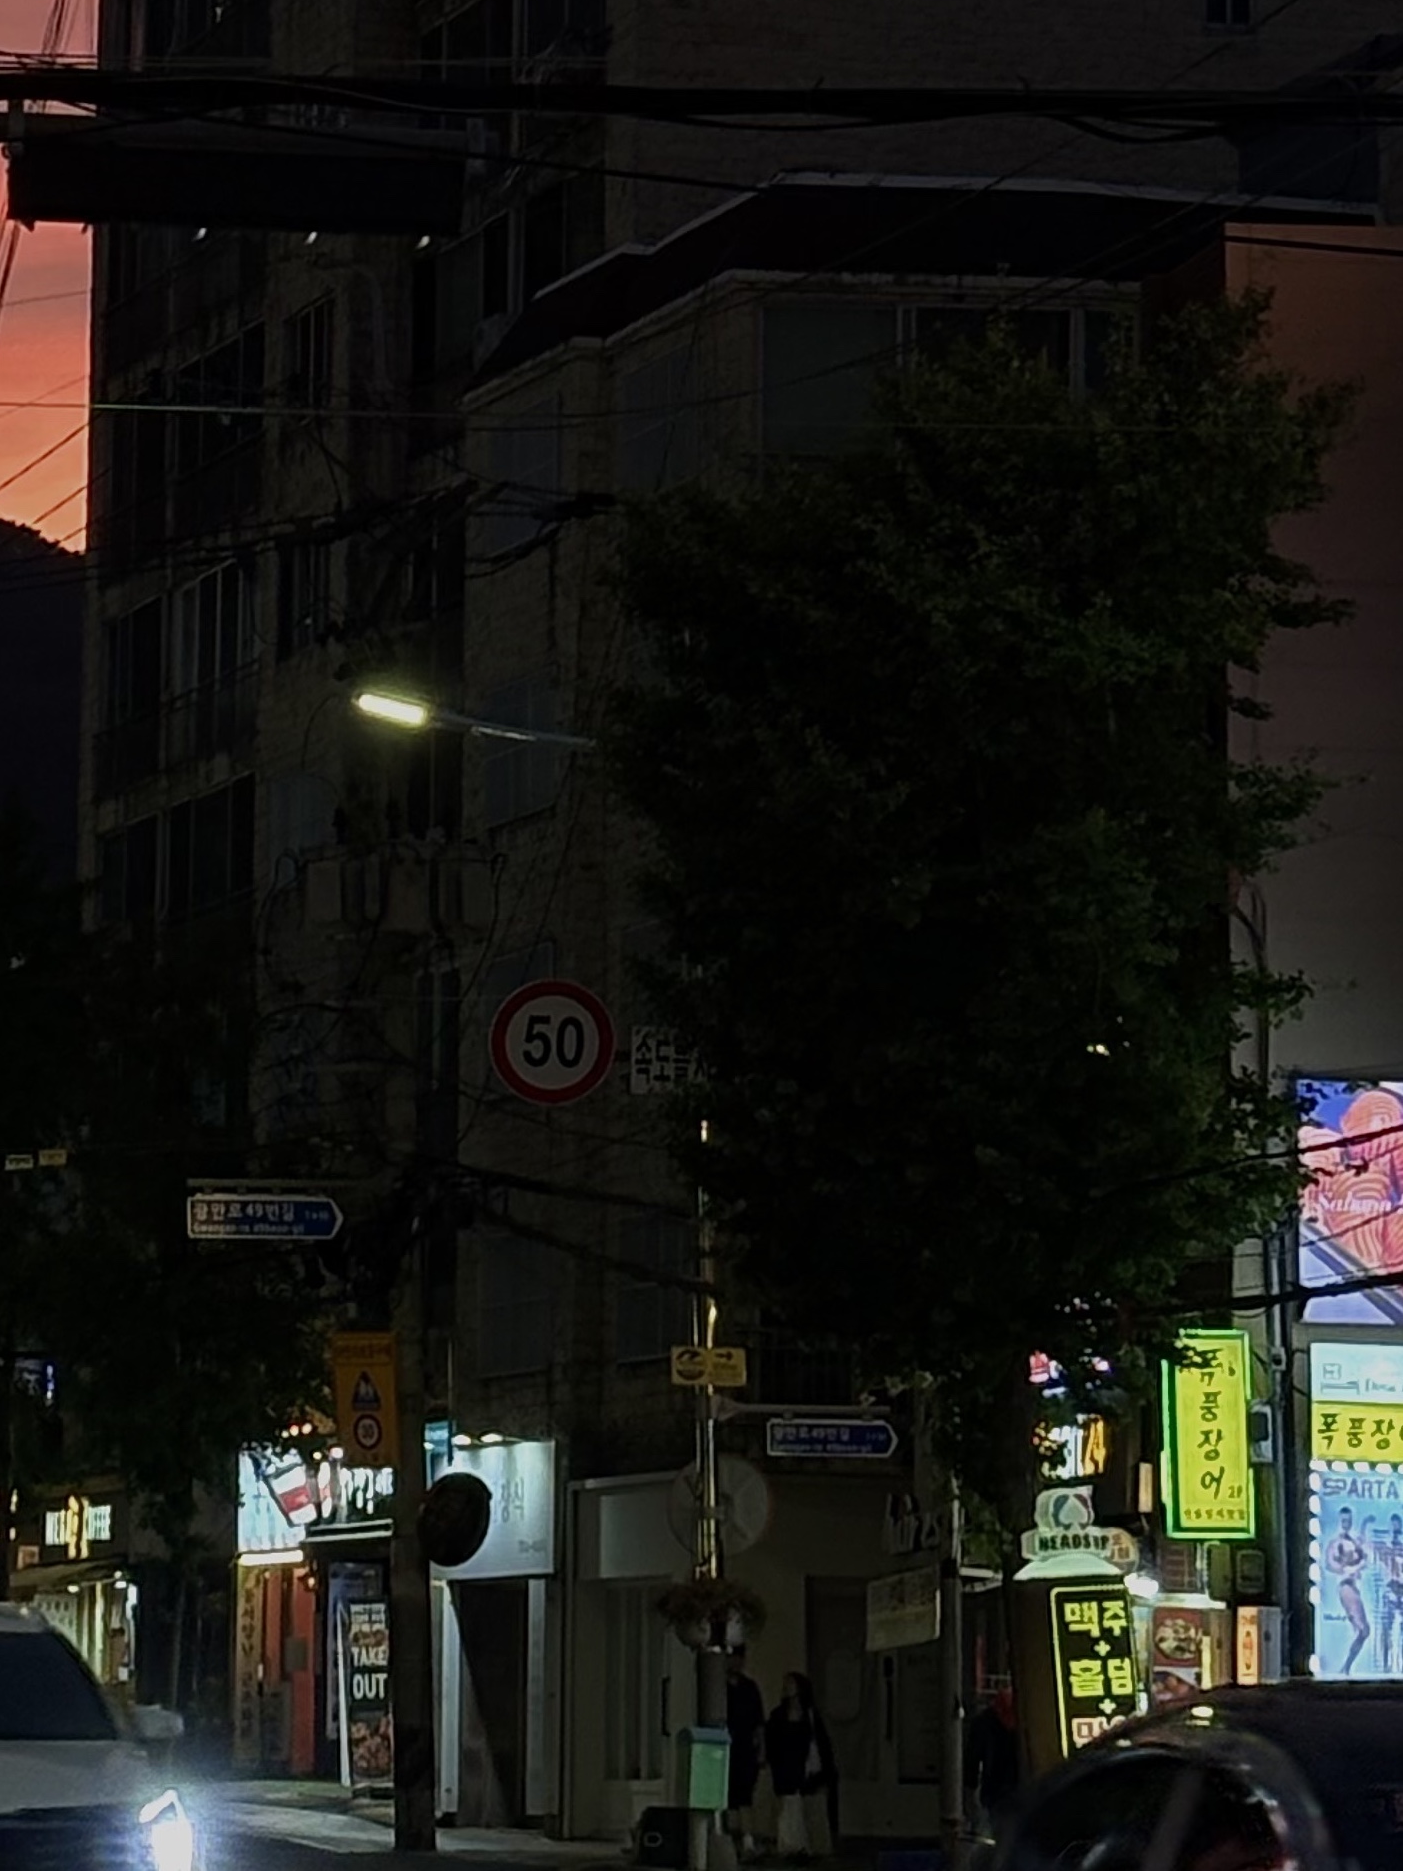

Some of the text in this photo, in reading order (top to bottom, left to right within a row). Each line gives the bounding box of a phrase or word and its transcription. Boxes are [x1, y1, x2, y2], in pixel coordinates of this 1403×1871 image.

[523, 1015, 584, 1068] 50
[1317, 1413, 1403, 1450] 폭풍장
[1321, 1477, 1400, 1501] SPARTA
[1063, 1601, 1128, 1638] 맥주
[351, 1646, 388, 1668] TAKE
[352, 1672, 389, 1700] OUT
[1069, 1656, 1133, 1697] 홀덤
